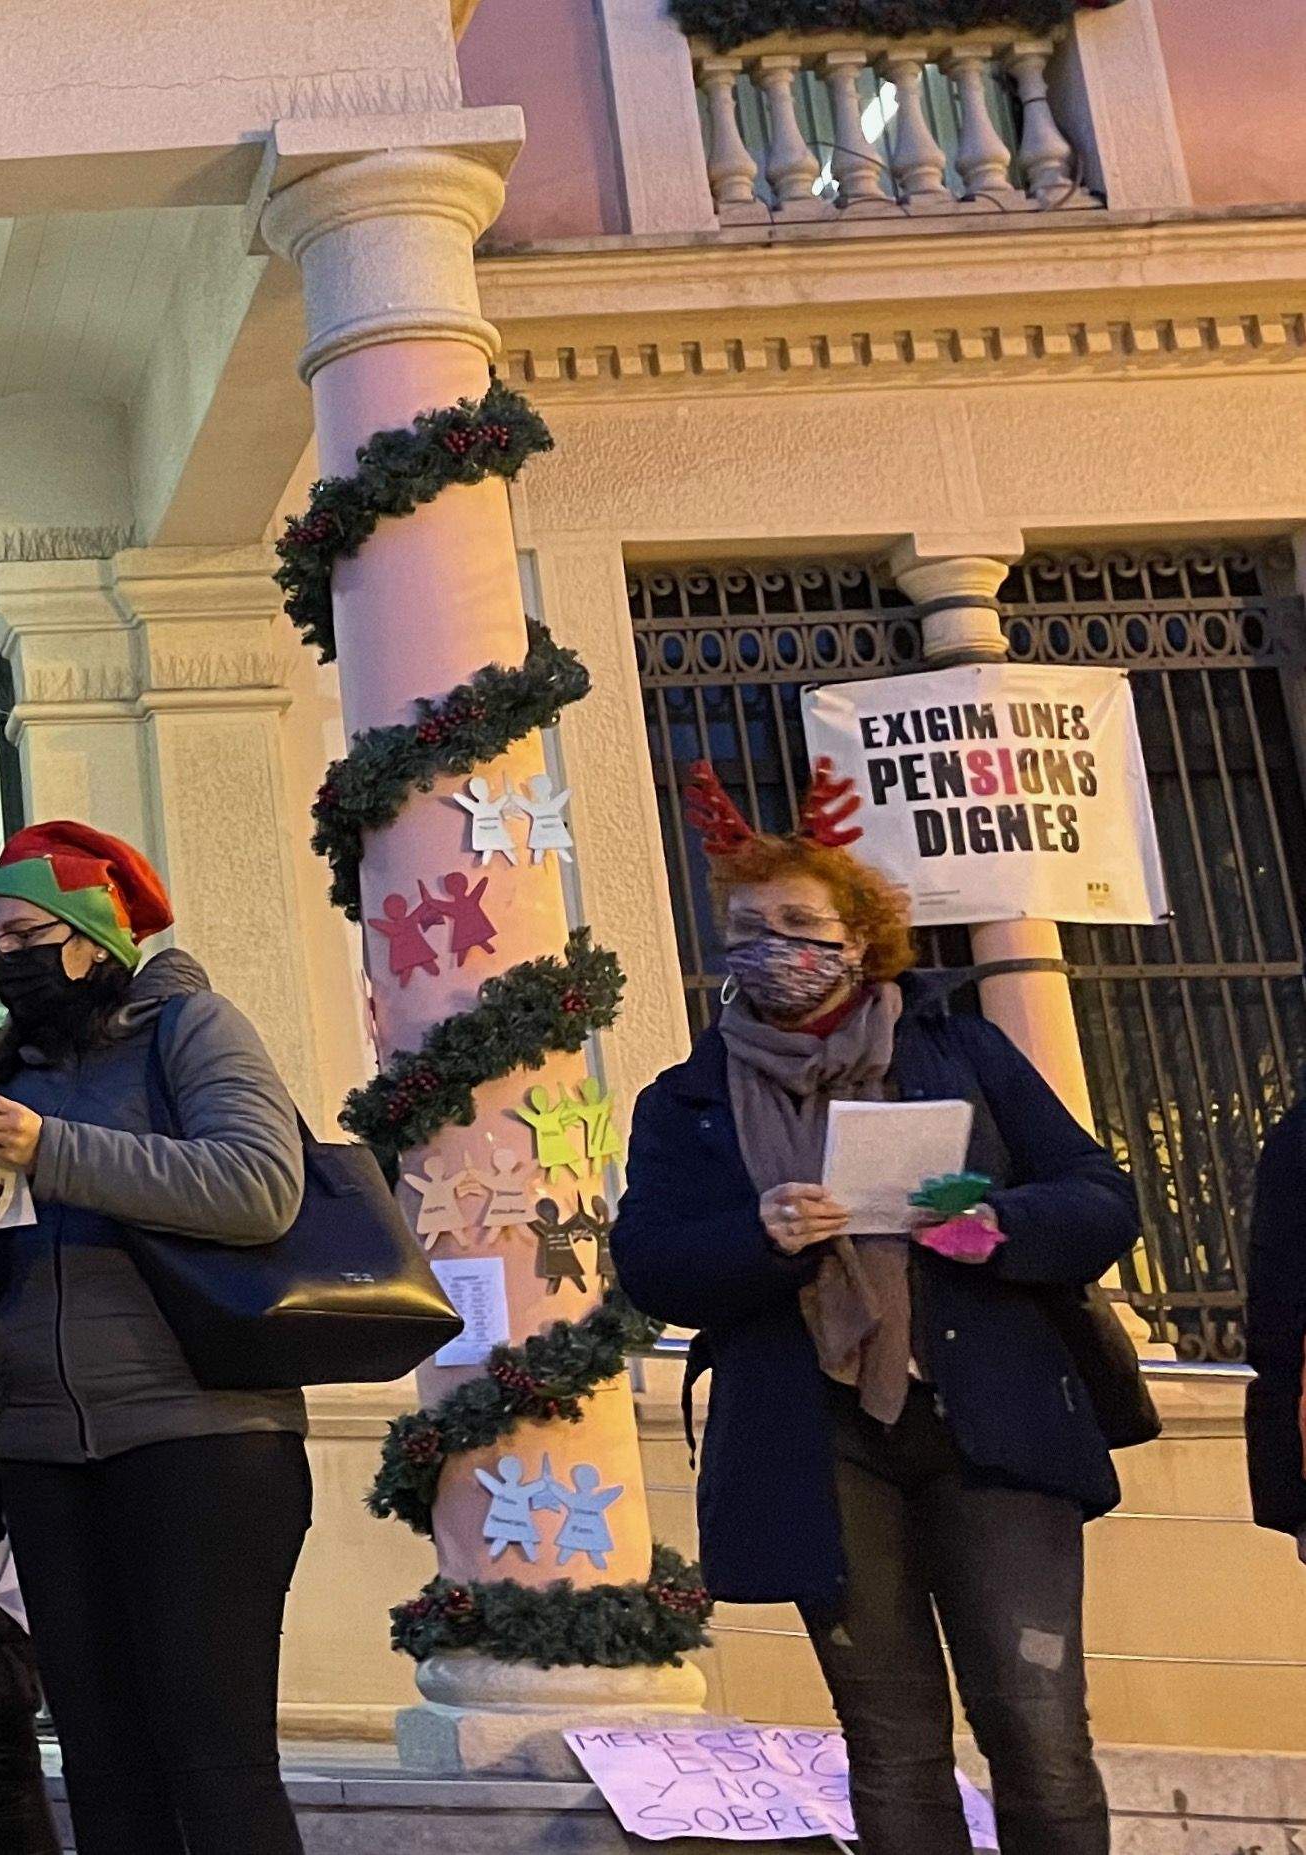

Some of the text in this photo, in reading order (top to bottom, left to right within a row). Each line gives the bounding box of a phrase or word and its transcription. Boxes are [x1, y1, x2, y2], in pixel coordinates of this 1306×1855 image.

[859, 702, 1090, 749] EXIGIM UNES
[867, 747, 1098, 806] PENSIONS
[913, 803, 1080, 858] DIGNES
[715, 1777, 780, 1799] NO
